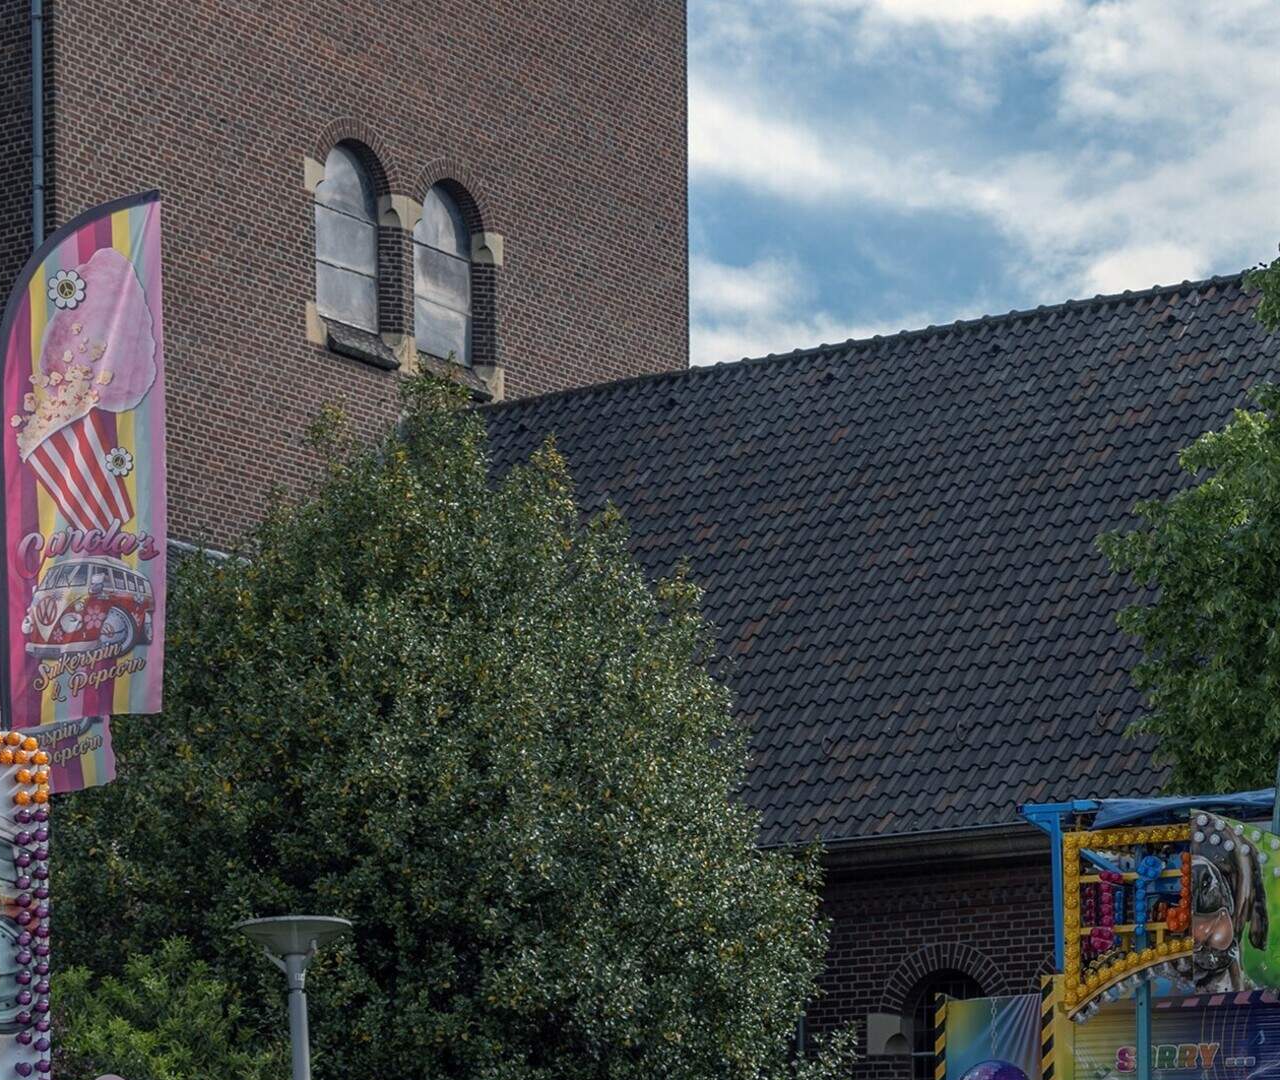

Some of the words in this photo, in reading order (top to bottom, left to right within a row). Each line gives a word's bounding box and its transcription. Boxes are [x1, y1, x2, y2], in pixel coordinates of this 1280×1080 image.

[16, 517, 160, 580] Carola's
[33, 642, 120, 691] Suikerspin
[70, 656, 146, 697] Popcorn
[1116, 1043, 1220, 1073] SRRY
